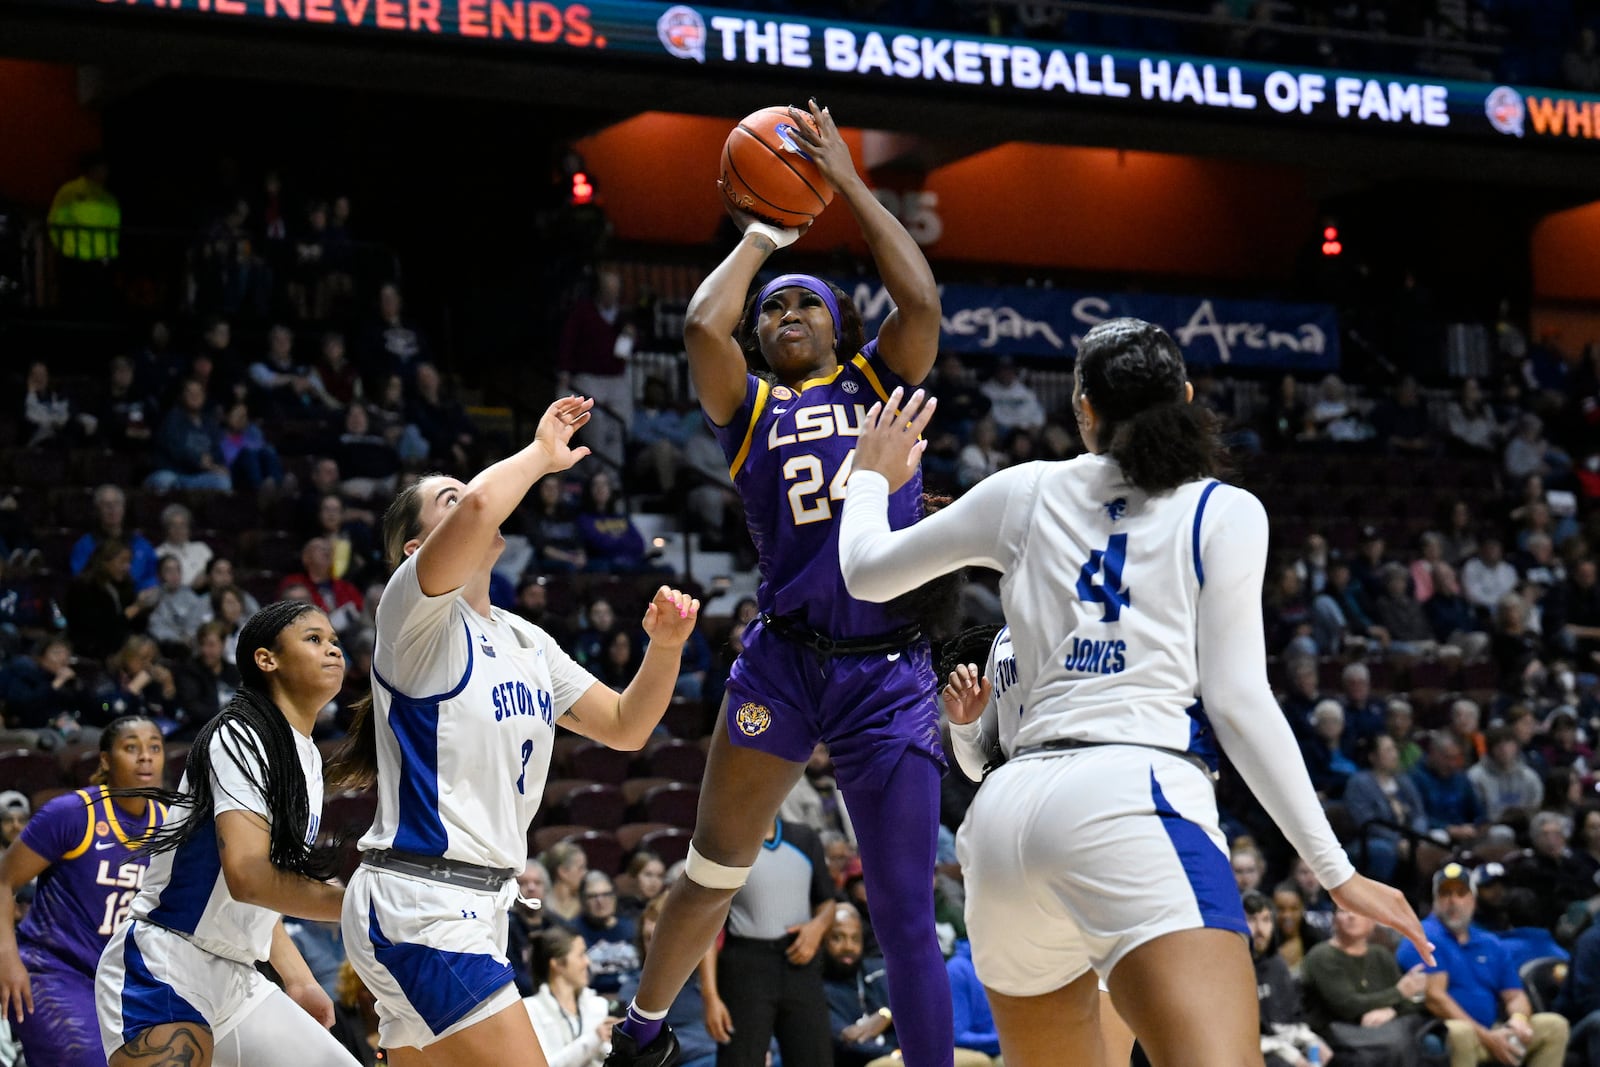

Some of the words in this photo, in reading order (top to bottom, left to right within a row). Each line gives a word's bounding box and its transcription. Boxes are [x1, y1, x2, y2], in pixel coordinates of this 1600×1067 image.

[457, 0, 607, 48] ENDS.
[711, 15, 812, 68] THE
[823, 26, 1131, 98] BASKETBALL
[1139, 57, 1257, 110] HALL
[1264, 71, 1326, 114] OF
[1335, 77, 1450, 127] FAME
[853, 282, 1064, 349] Megan
[1174, 299, 1327, 363] Arena
[768, 403, 868, 451] LSU
[1076, 532, 1131, 623] 4
[1065, 636, 1127, 675] JONES
[492, 680, 535, 722] SETON
[537, 688, 556, 737] HA
